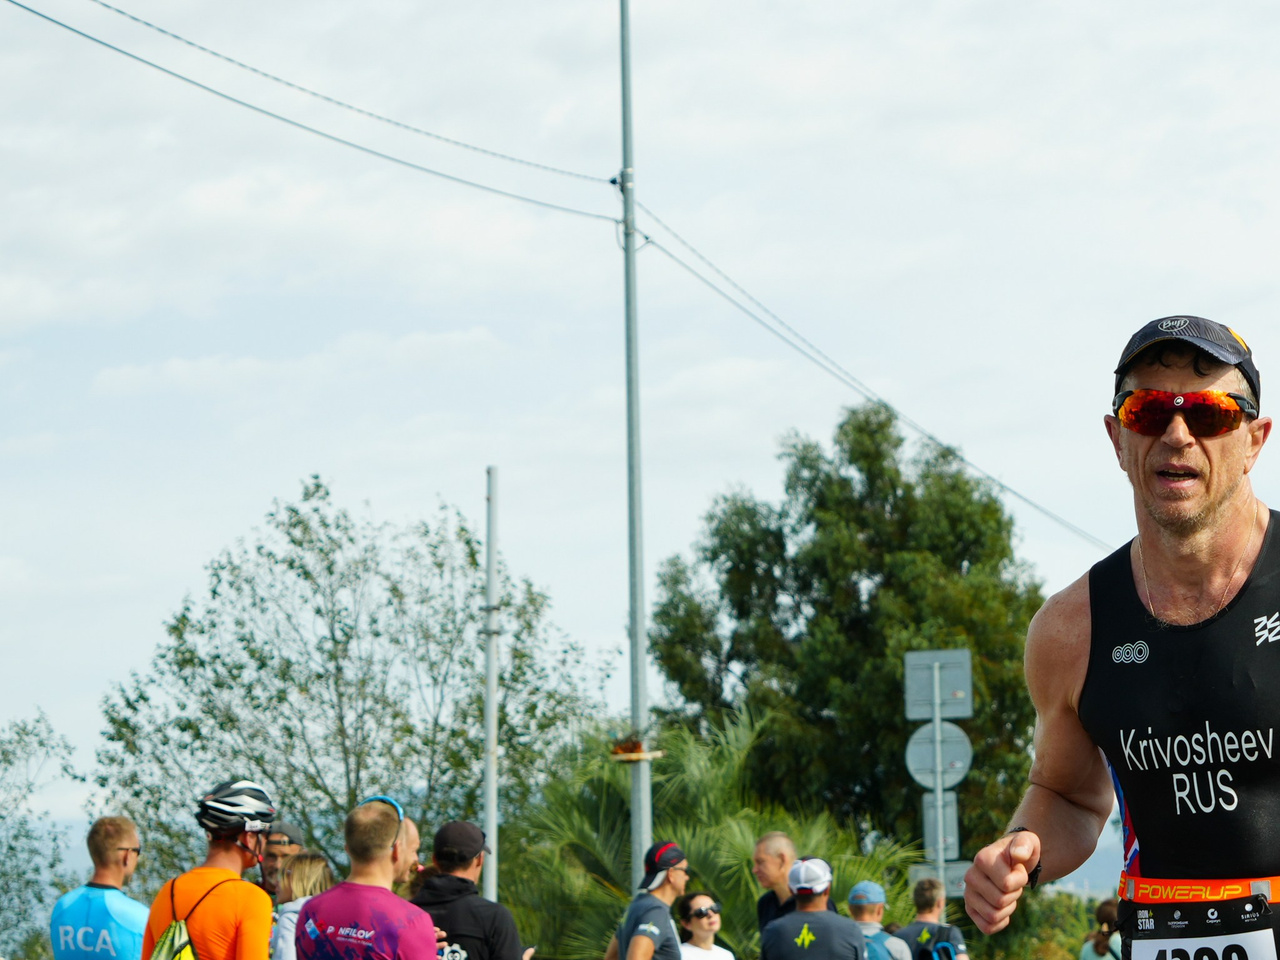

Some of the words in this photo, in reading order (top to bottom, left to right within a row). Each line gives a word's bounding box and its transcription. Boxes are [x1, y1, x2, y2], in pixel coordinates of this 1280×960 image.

[1163, 319, 1186, 329] Buff
[1120, 721, 1273, 771] Krivosheev
[1172, 769, 1239, 815] RUS
[1138, 884, 1242, 900] POWERUP
[1138, 919, 1154, 930] STAR
[58, 925, 116, 957] RCA
